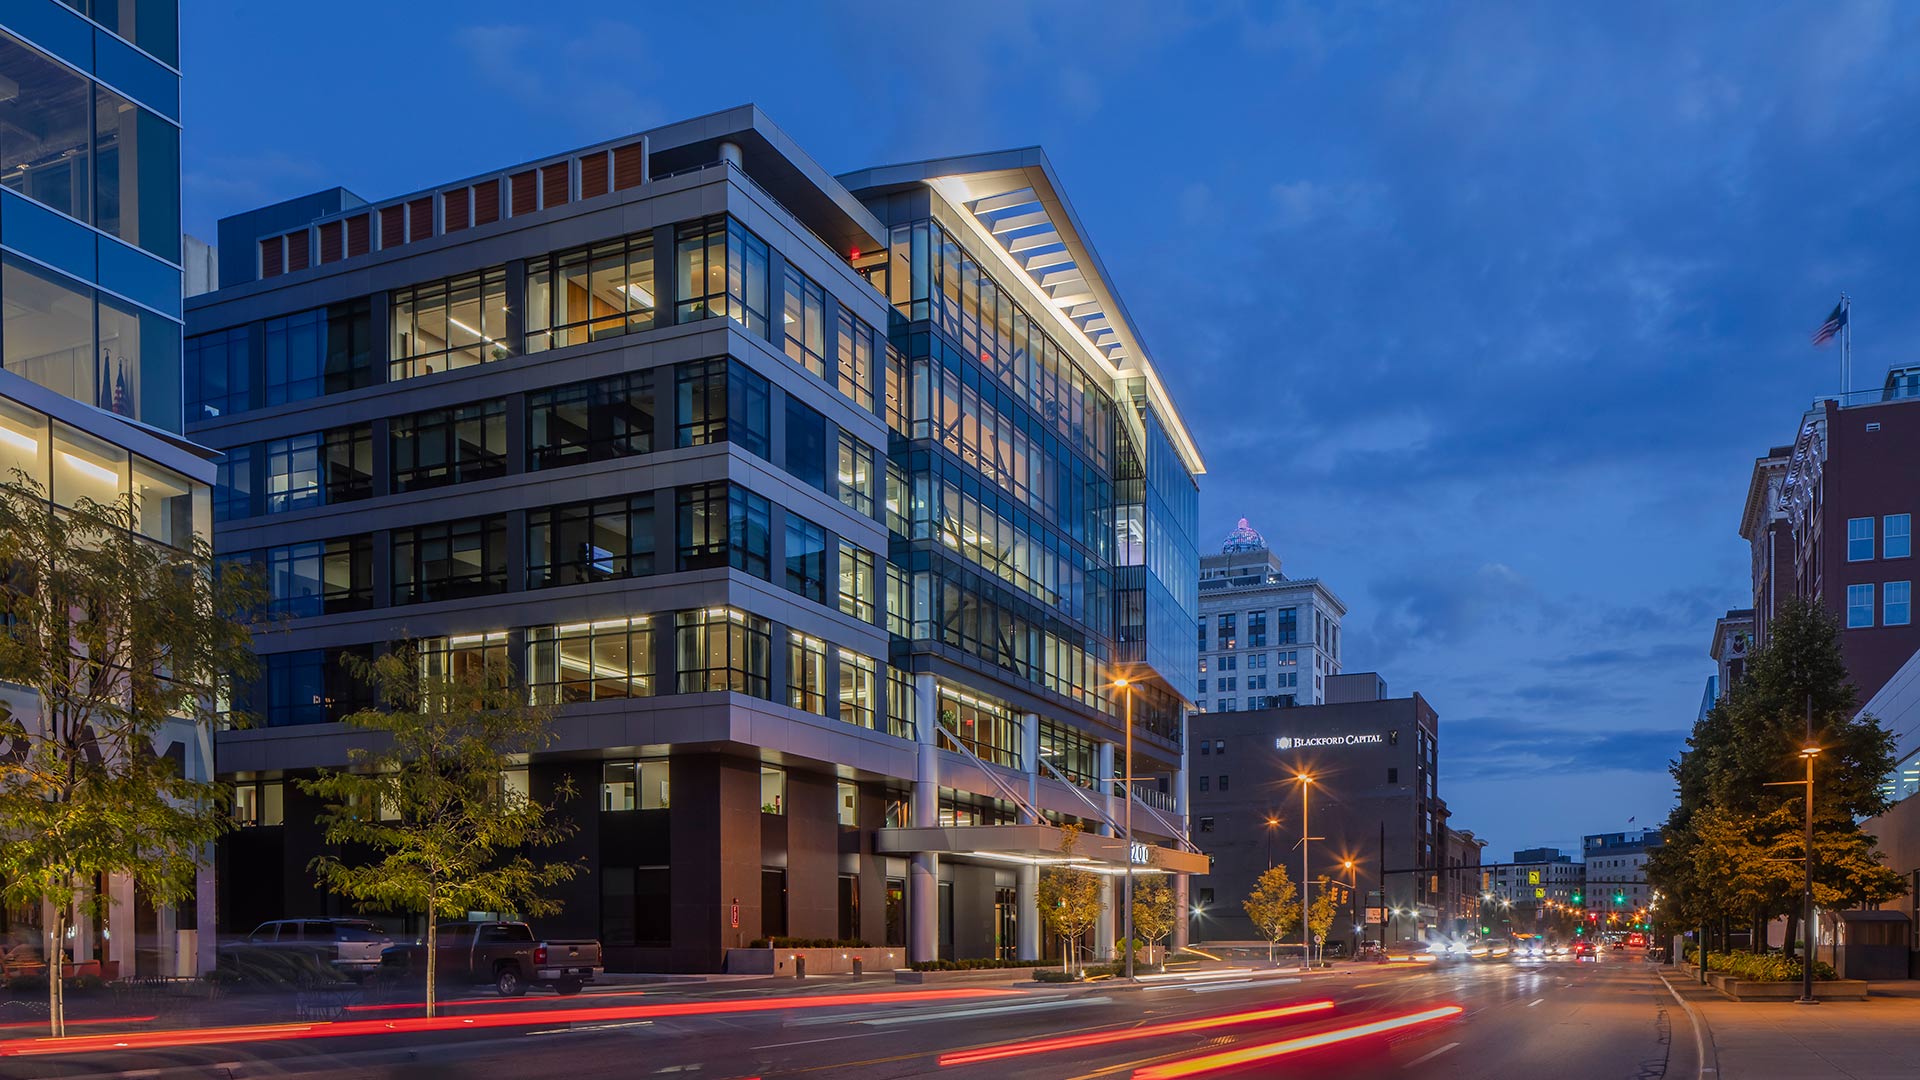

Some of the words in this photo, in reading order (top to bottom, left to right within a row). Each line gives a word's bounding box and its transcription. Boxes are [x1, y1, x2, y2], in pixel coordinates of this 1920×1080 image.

[1293, 736, 1344, 748] BLACKFORD
[1345, 734, 1382, 745] CAPITAL
[1131, 843, 1149, 862] 200
